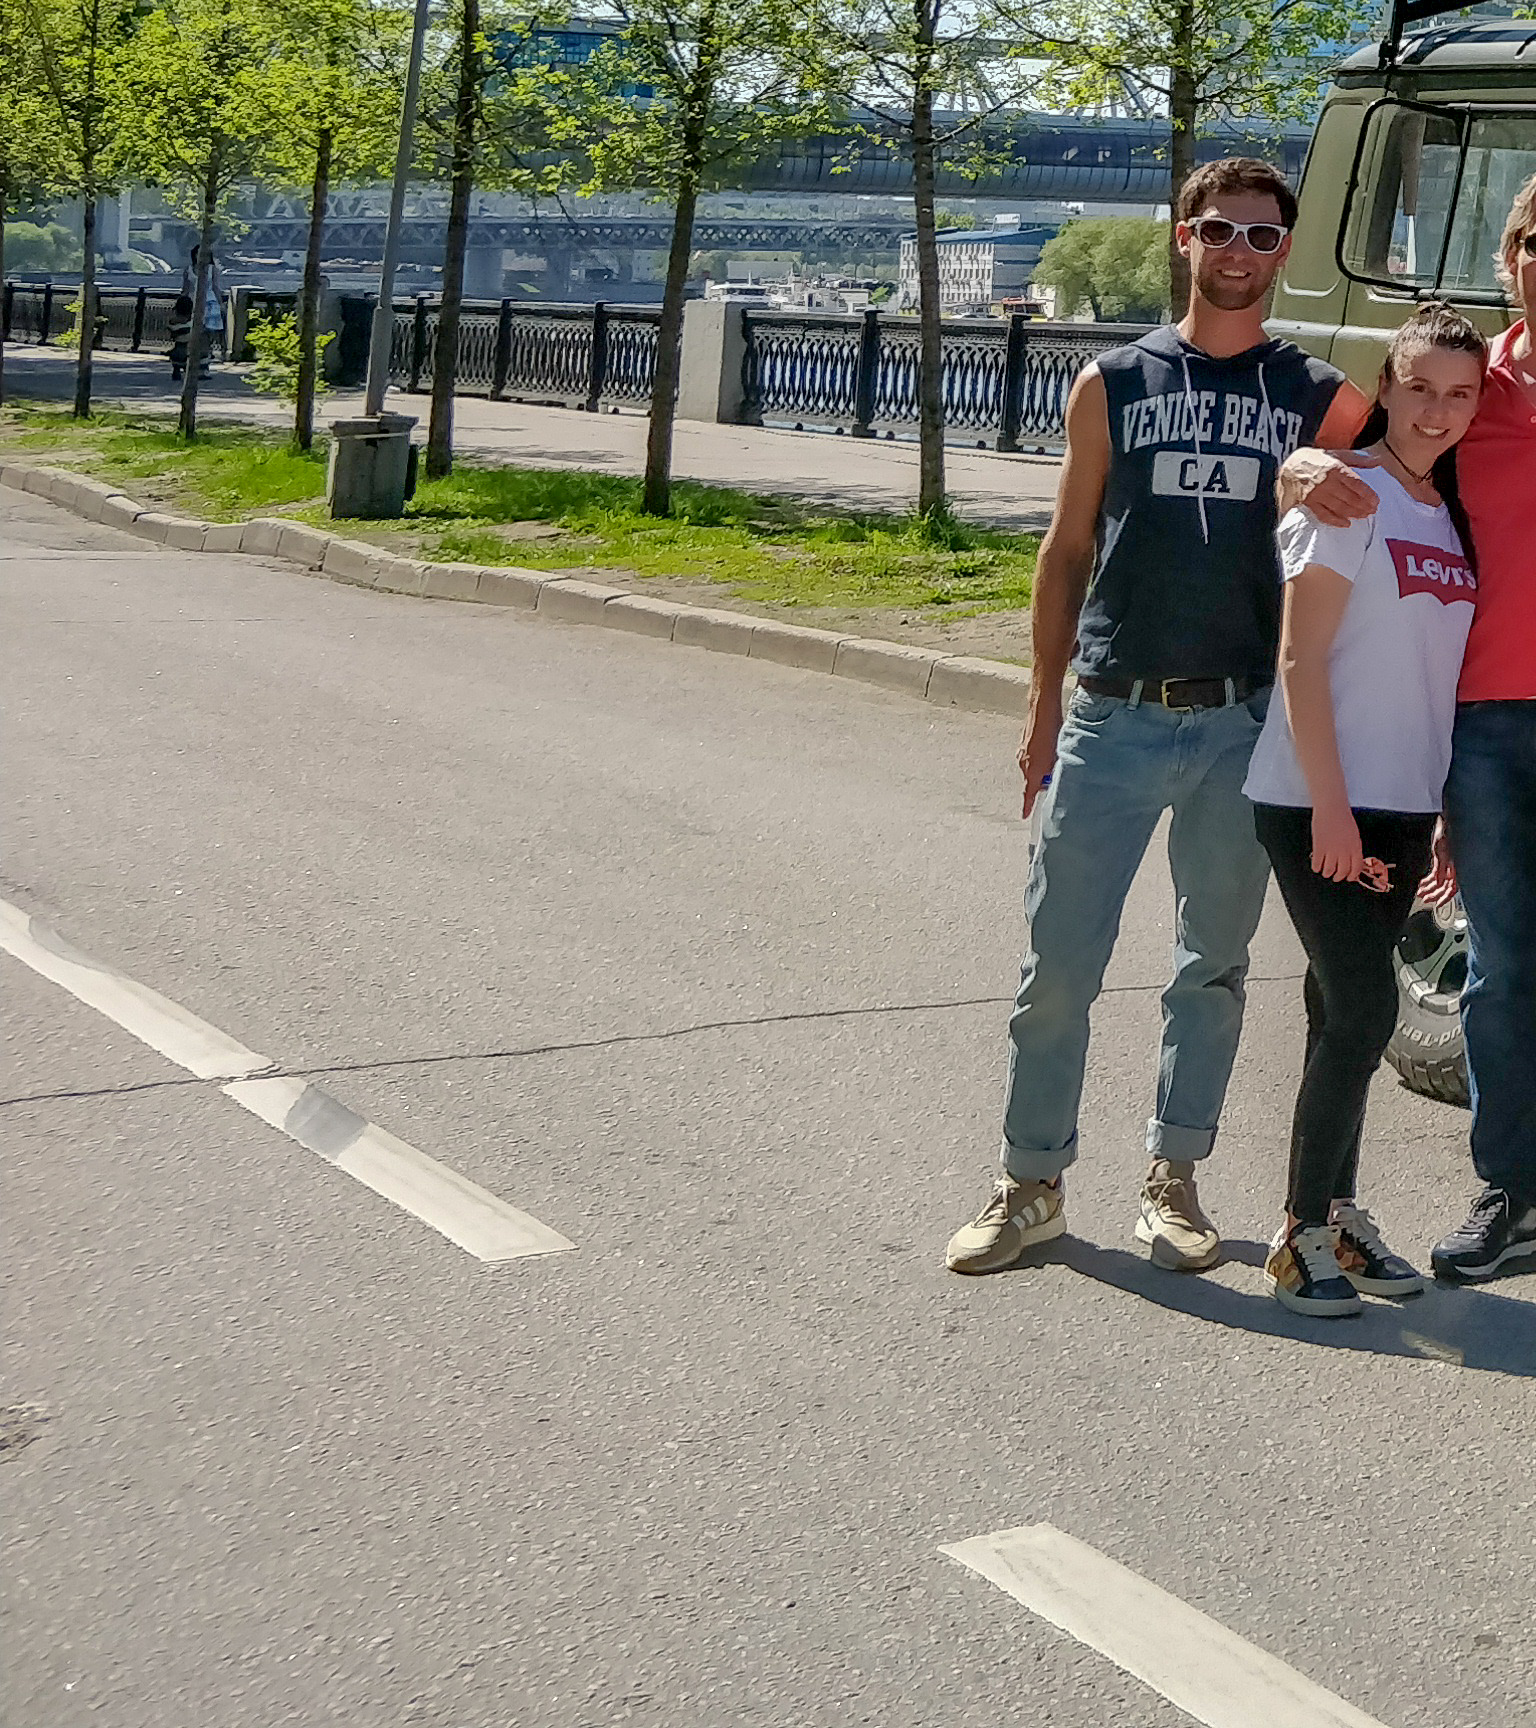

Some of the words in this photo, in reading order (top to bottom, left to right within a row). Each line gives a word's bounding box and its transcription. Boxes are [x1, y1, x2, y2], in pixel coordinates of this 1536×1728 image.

[1123, 390, 1217, 454] VENICE
[1220, 393, 1303, 460] BEACH
[1179, 459, 1231, 493] CA
